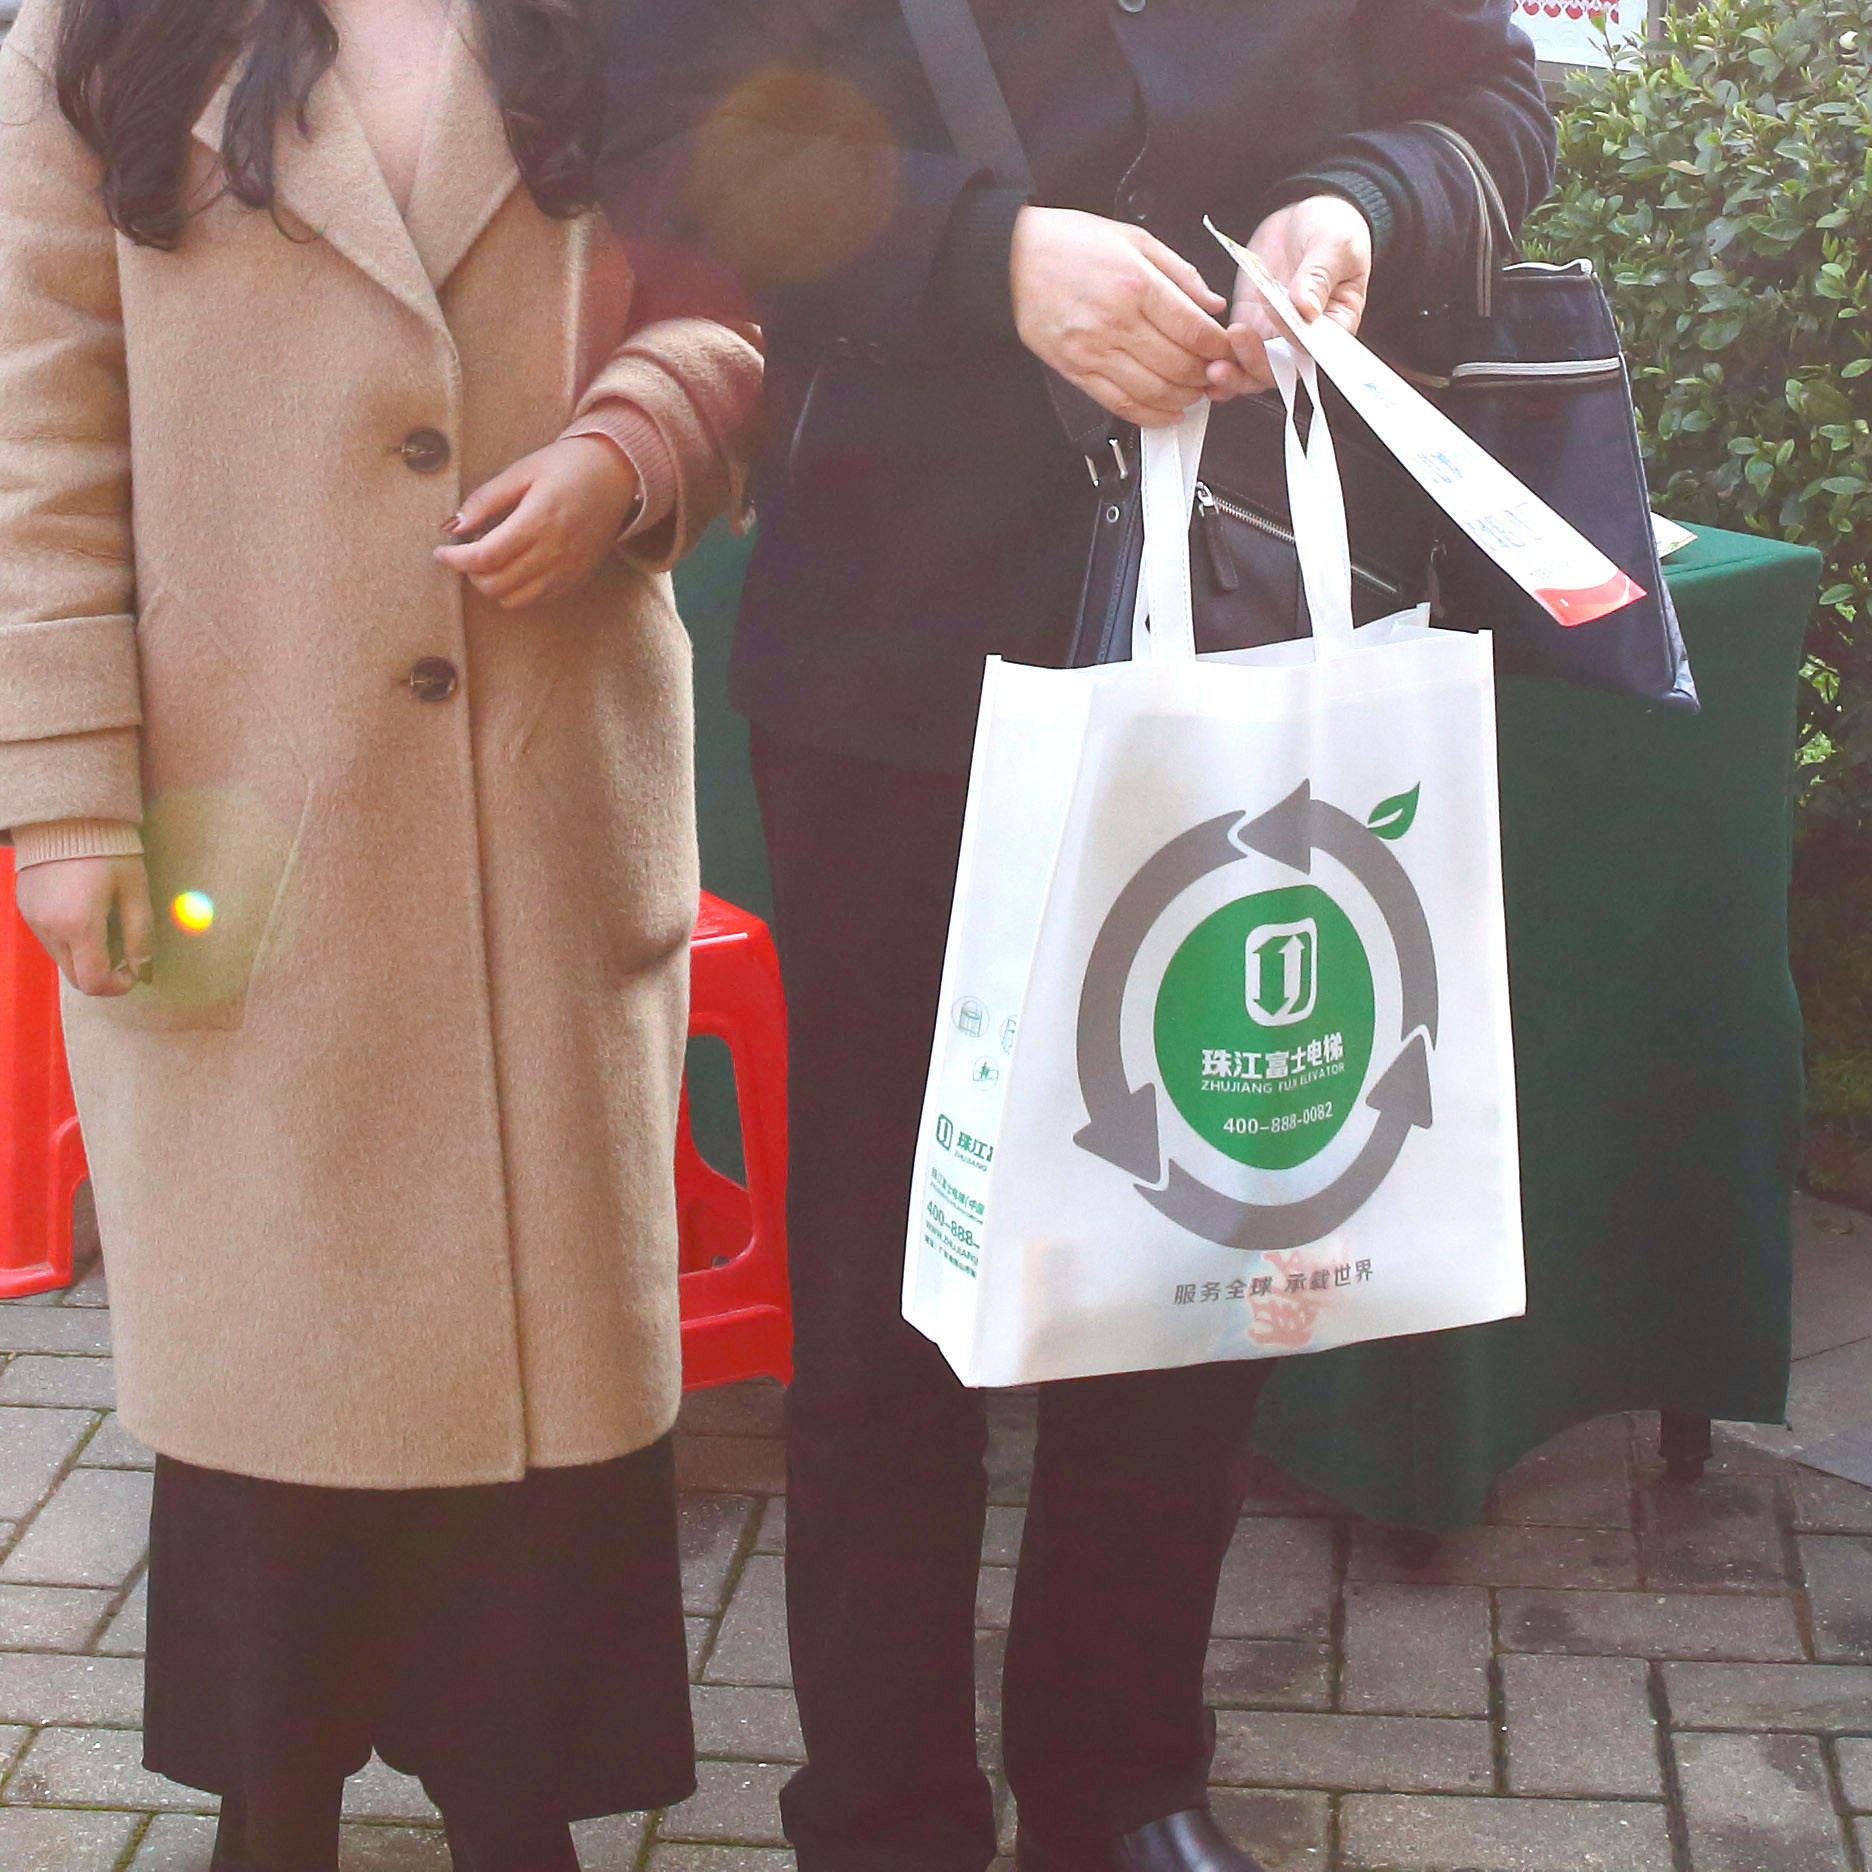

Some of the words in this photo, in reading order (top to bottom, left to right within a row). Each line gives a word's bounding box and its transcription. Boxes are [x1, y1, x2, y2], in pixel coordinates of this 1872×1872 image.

[1201, 1032, 1344, 1079] 珠江富士电梯
[1201, 1079, 1273, 1094] ZHUJIANG
[1223, 1101, 1334, 1134] 400-888-0082
[956, 1131, 994, 1162] 珠江
[1173, 1275, 1273, 1305] 服务全球
